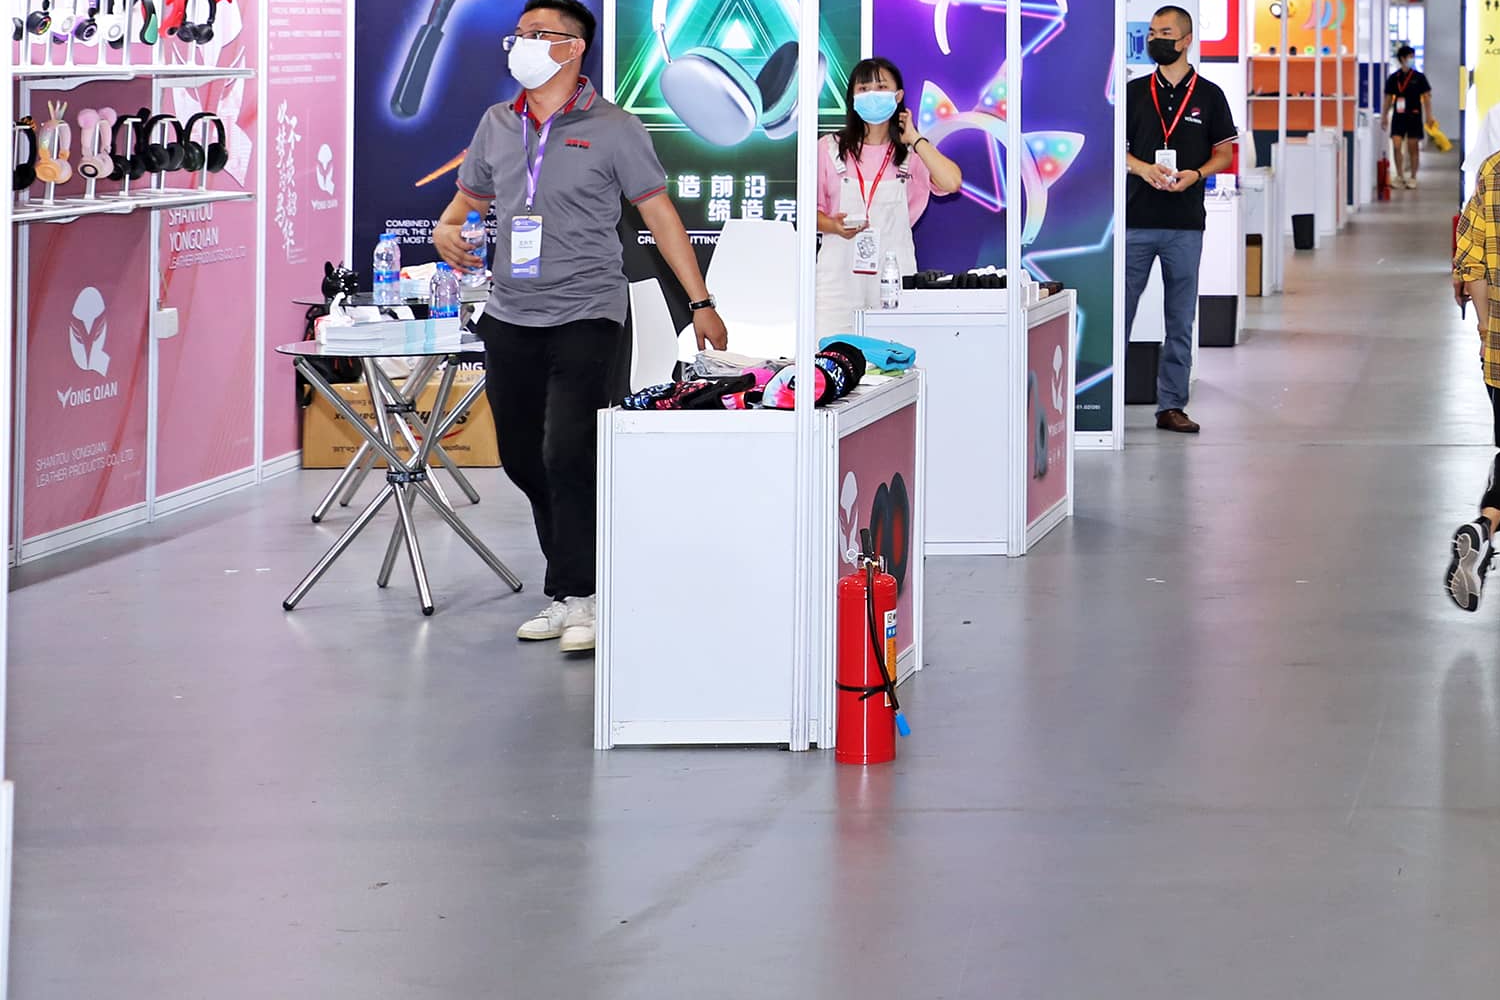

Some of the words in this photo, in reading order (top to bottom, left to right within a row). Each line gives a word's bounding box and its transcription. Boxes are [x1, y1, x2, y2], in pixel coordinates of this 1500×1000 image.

[385, 219, 430, 228] COMBINED
[168, 226, 219, 253] YONGQIAN
[402, 236, 427, 244] MOST
[57, 386, 91, 408] YONG
[93, 381, 118, 401] QIAN
